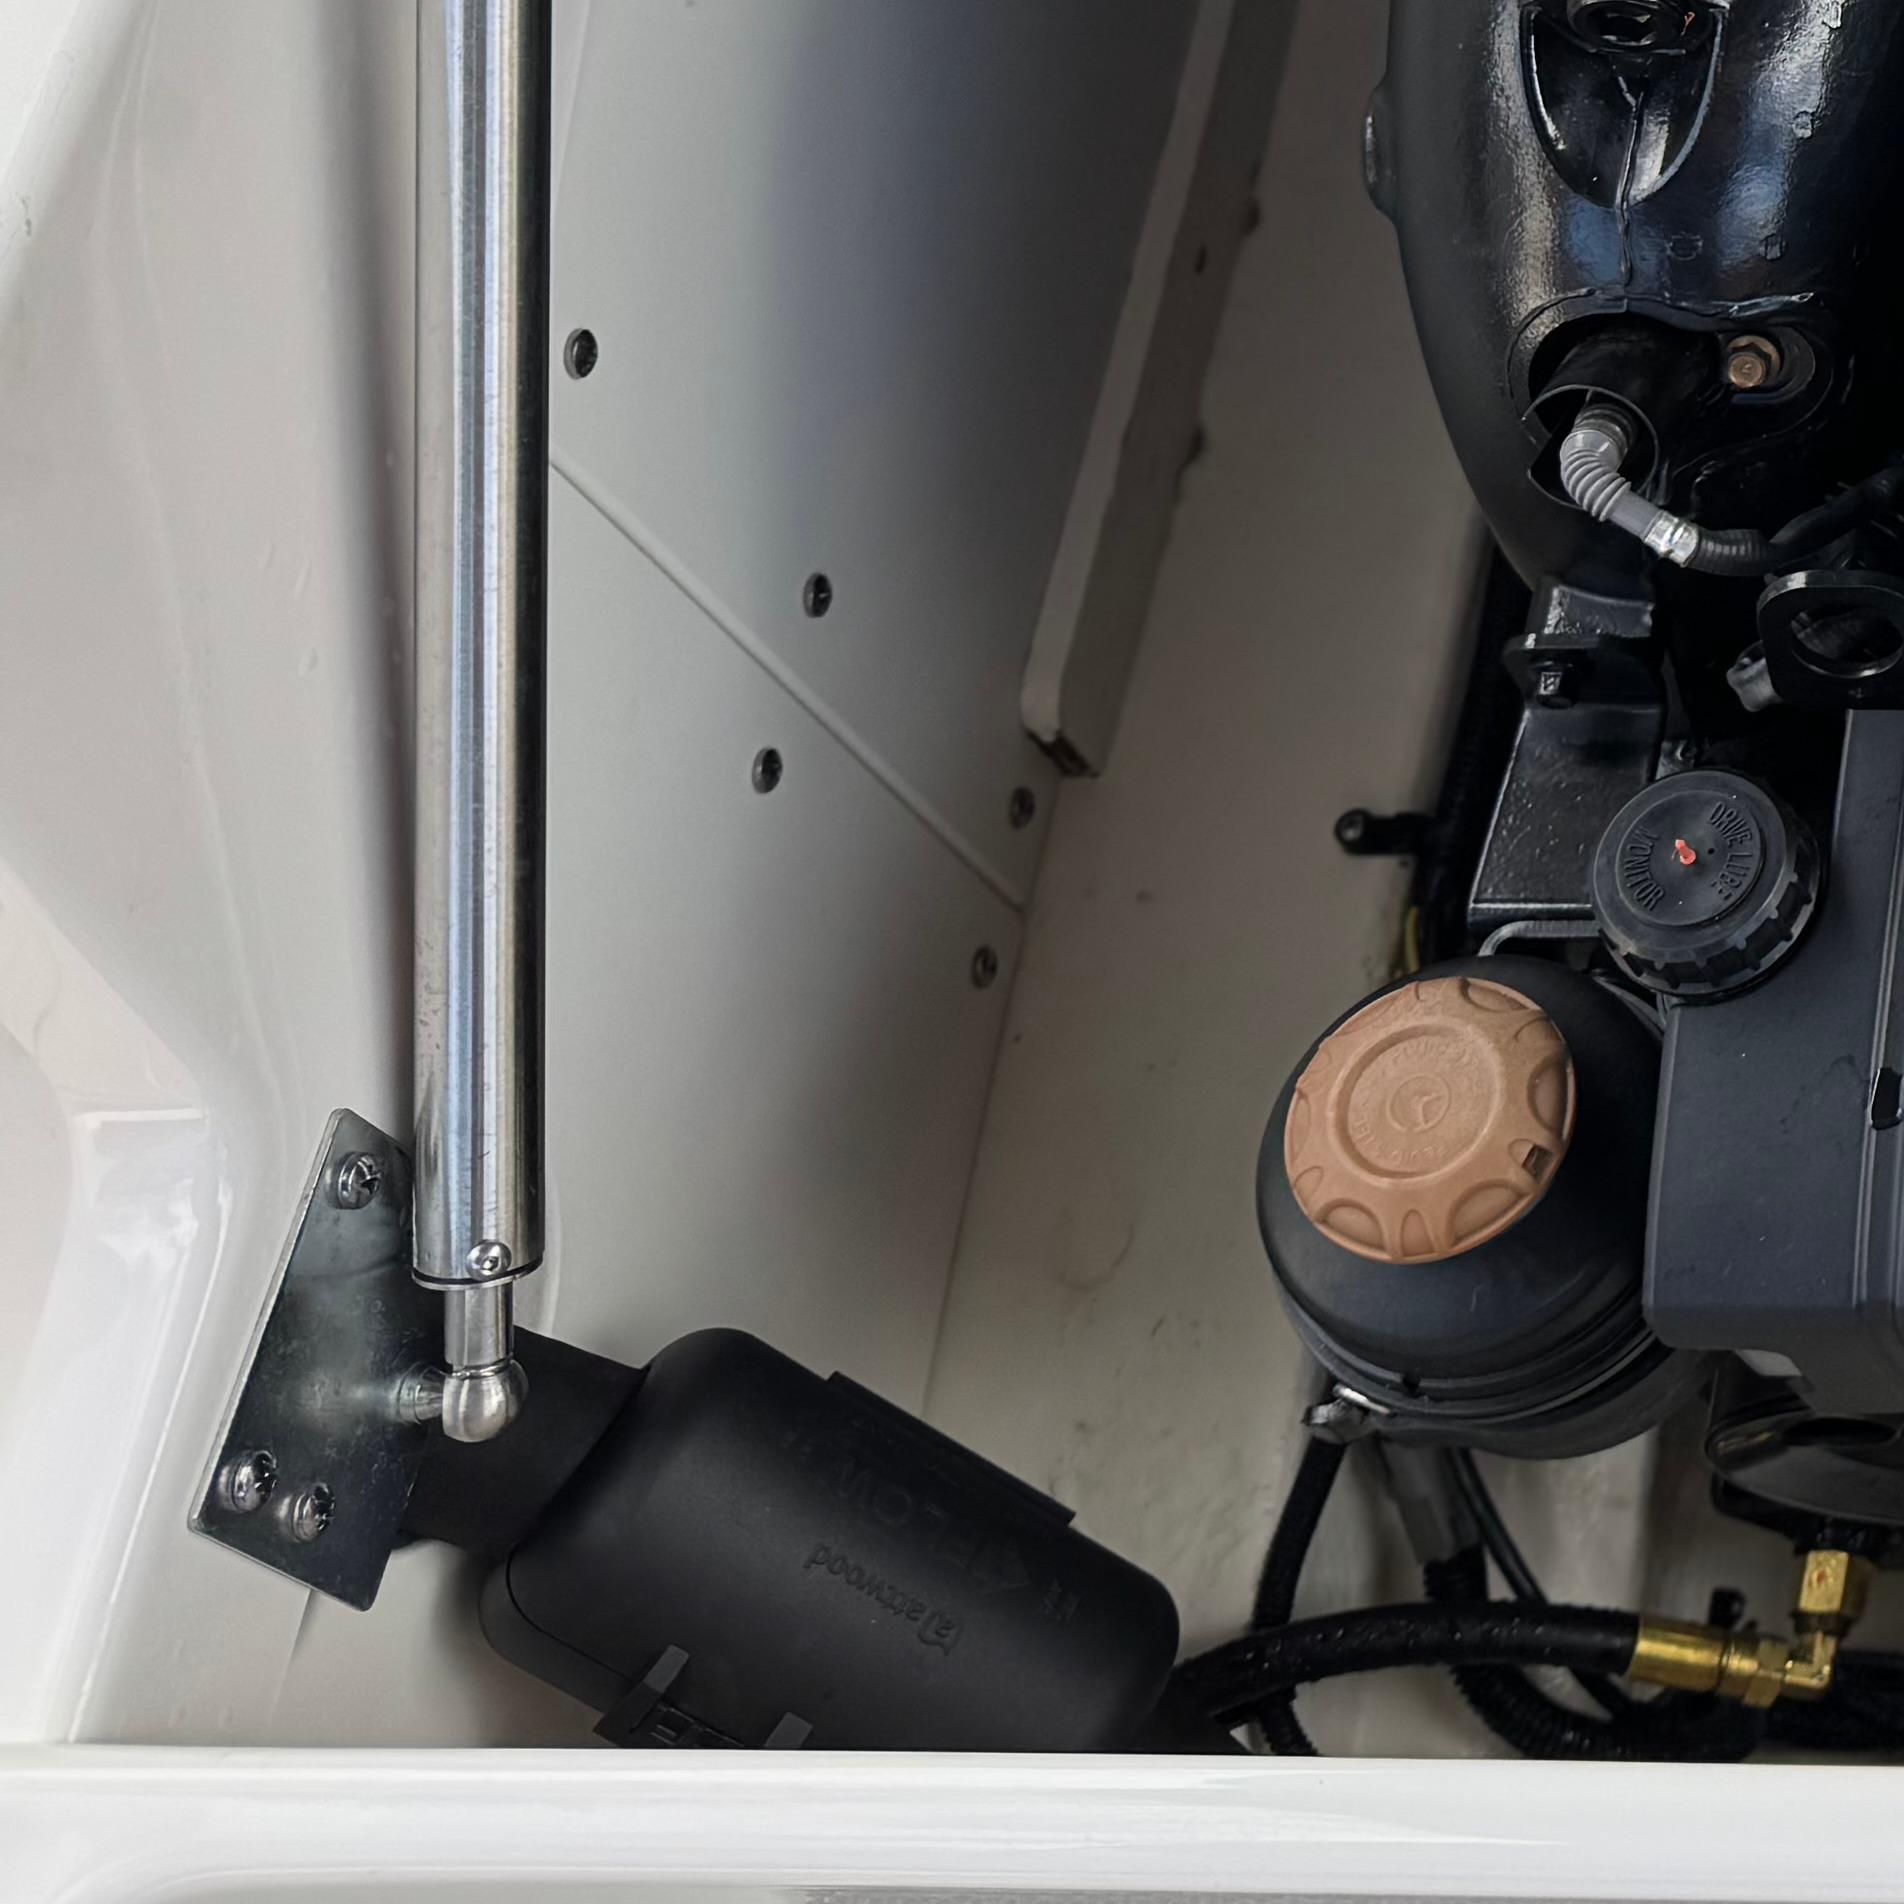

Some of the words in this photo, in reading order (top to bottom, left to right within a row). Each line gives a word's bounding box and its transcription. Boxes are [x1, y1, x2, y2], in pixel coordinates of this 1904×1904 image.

[1710, 801, 1752, 847] DRIVE
[1624, 826, 1664, 911] MONITOR
[803, 1543, 926, 1621] attwood
